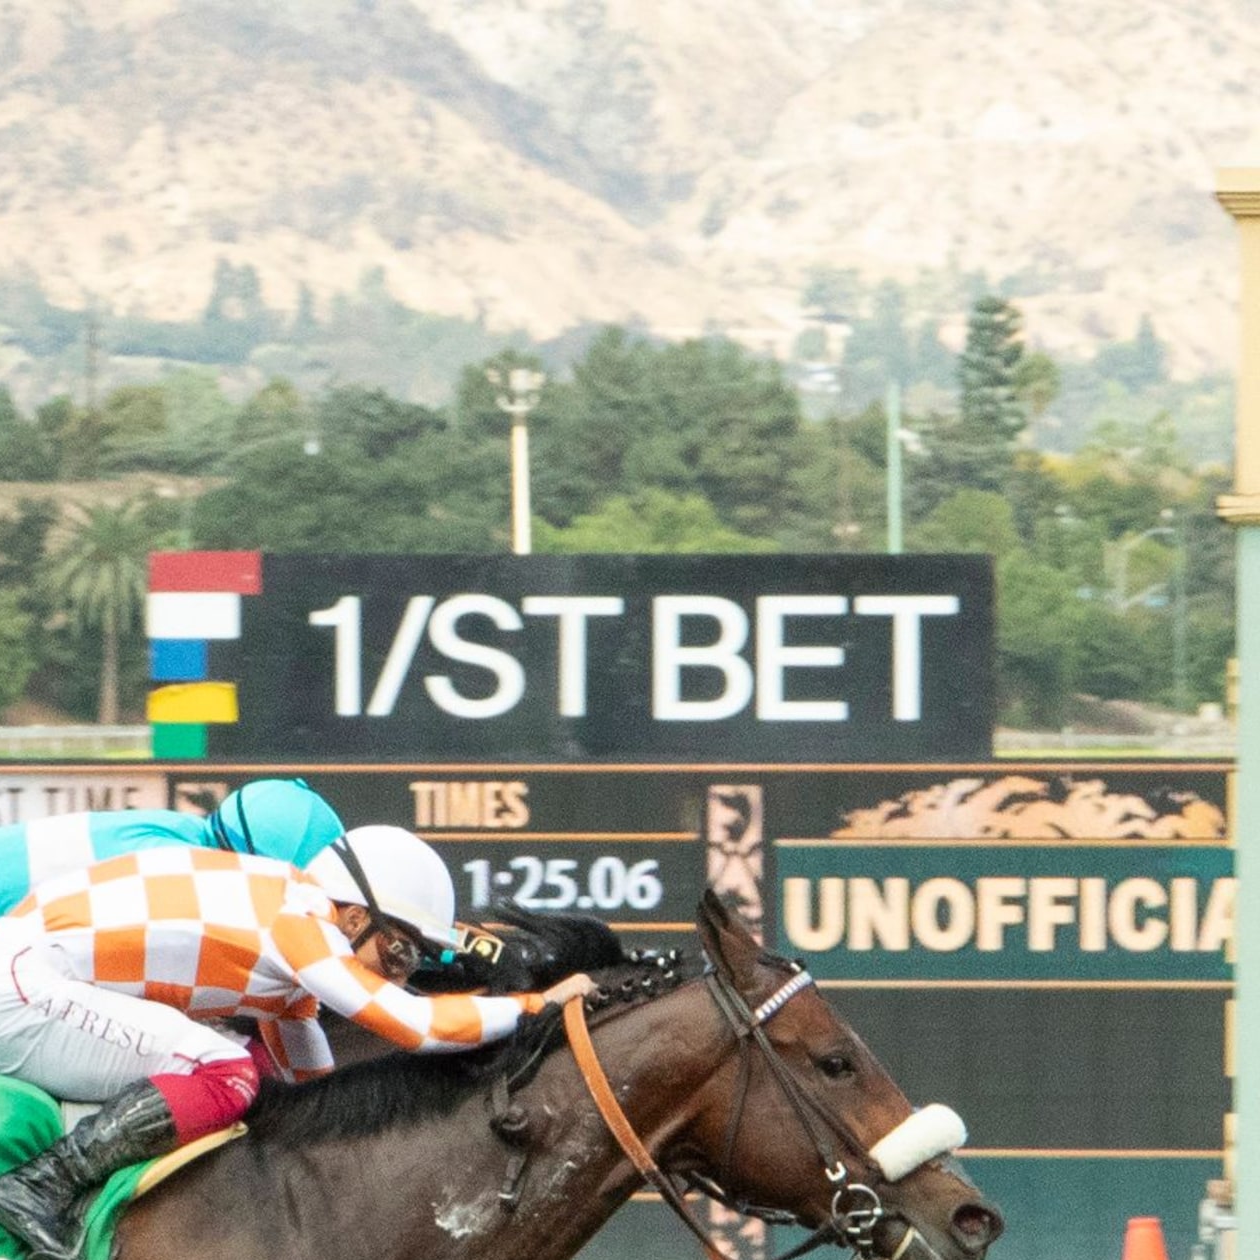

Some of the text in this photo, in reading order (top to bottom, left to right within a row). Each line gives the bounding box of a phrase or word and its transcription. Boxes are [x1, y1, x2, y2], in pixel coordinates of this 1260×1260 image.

[308, 594, 960, 722] 1/ST BET
[409, 780, 530, 829] TIMES
